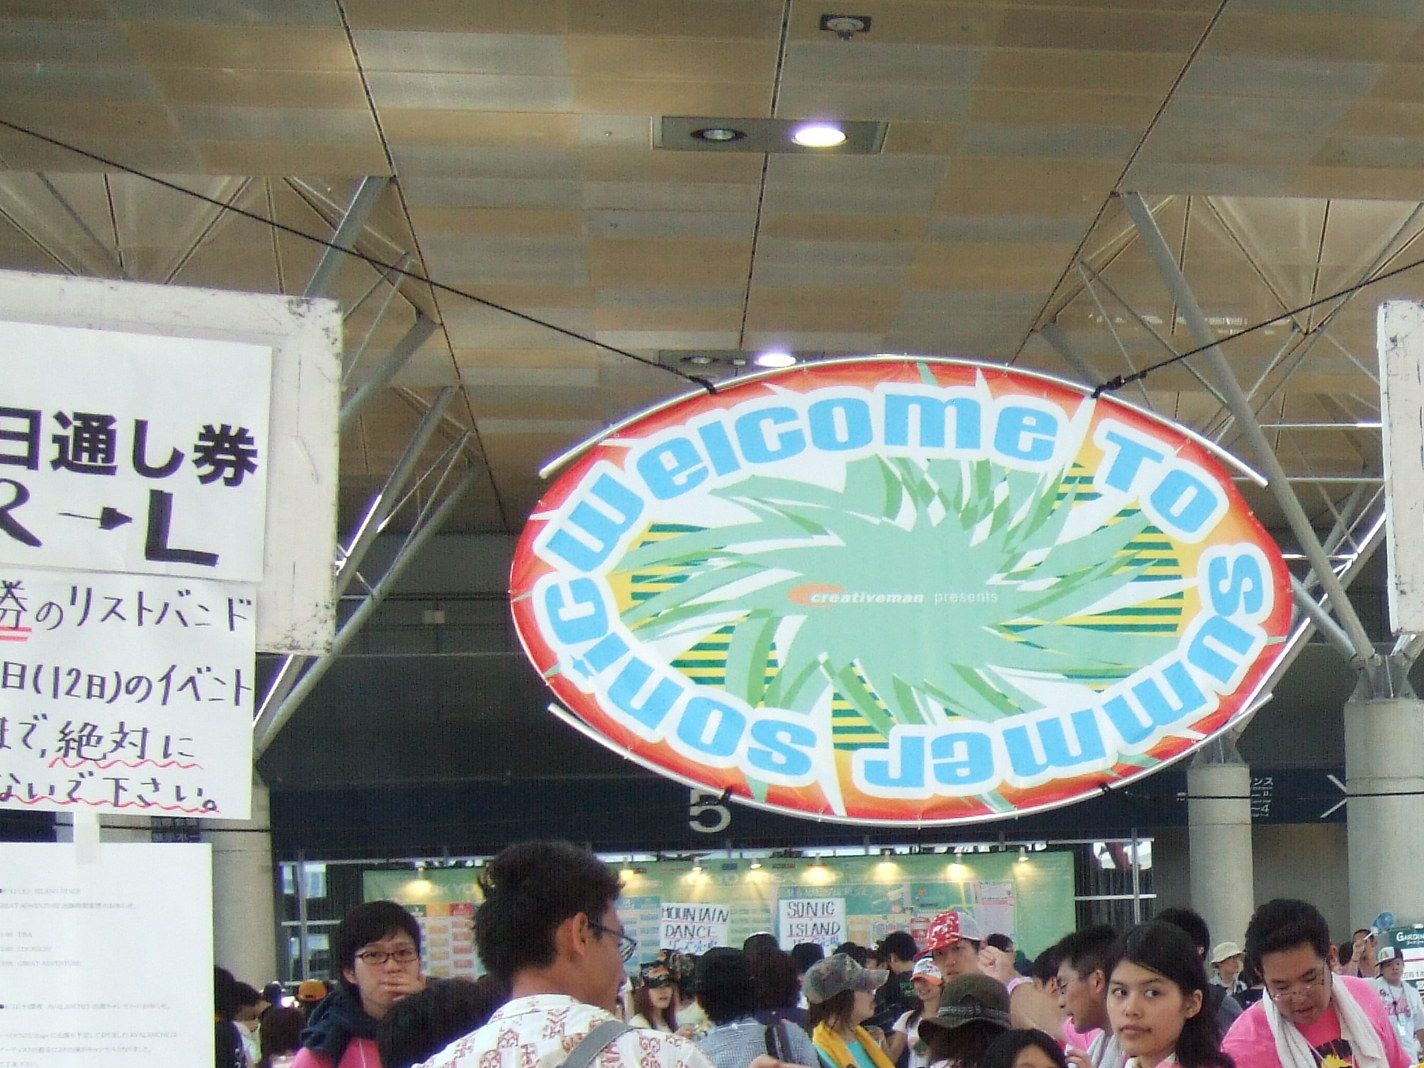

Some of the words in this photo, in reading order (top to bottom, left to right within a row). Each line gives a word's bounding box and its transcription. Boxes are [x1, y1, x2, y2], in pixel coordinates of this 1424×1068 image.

[145, 489, 219, 567] L
[810, 592, 925, 604] creativeman
[935, 591, 998, 606] presents
[689, 788, 731, 833] 5
[787, 900, 835, 917] SONIC
[787, 921, 841, 937] ISLAND
